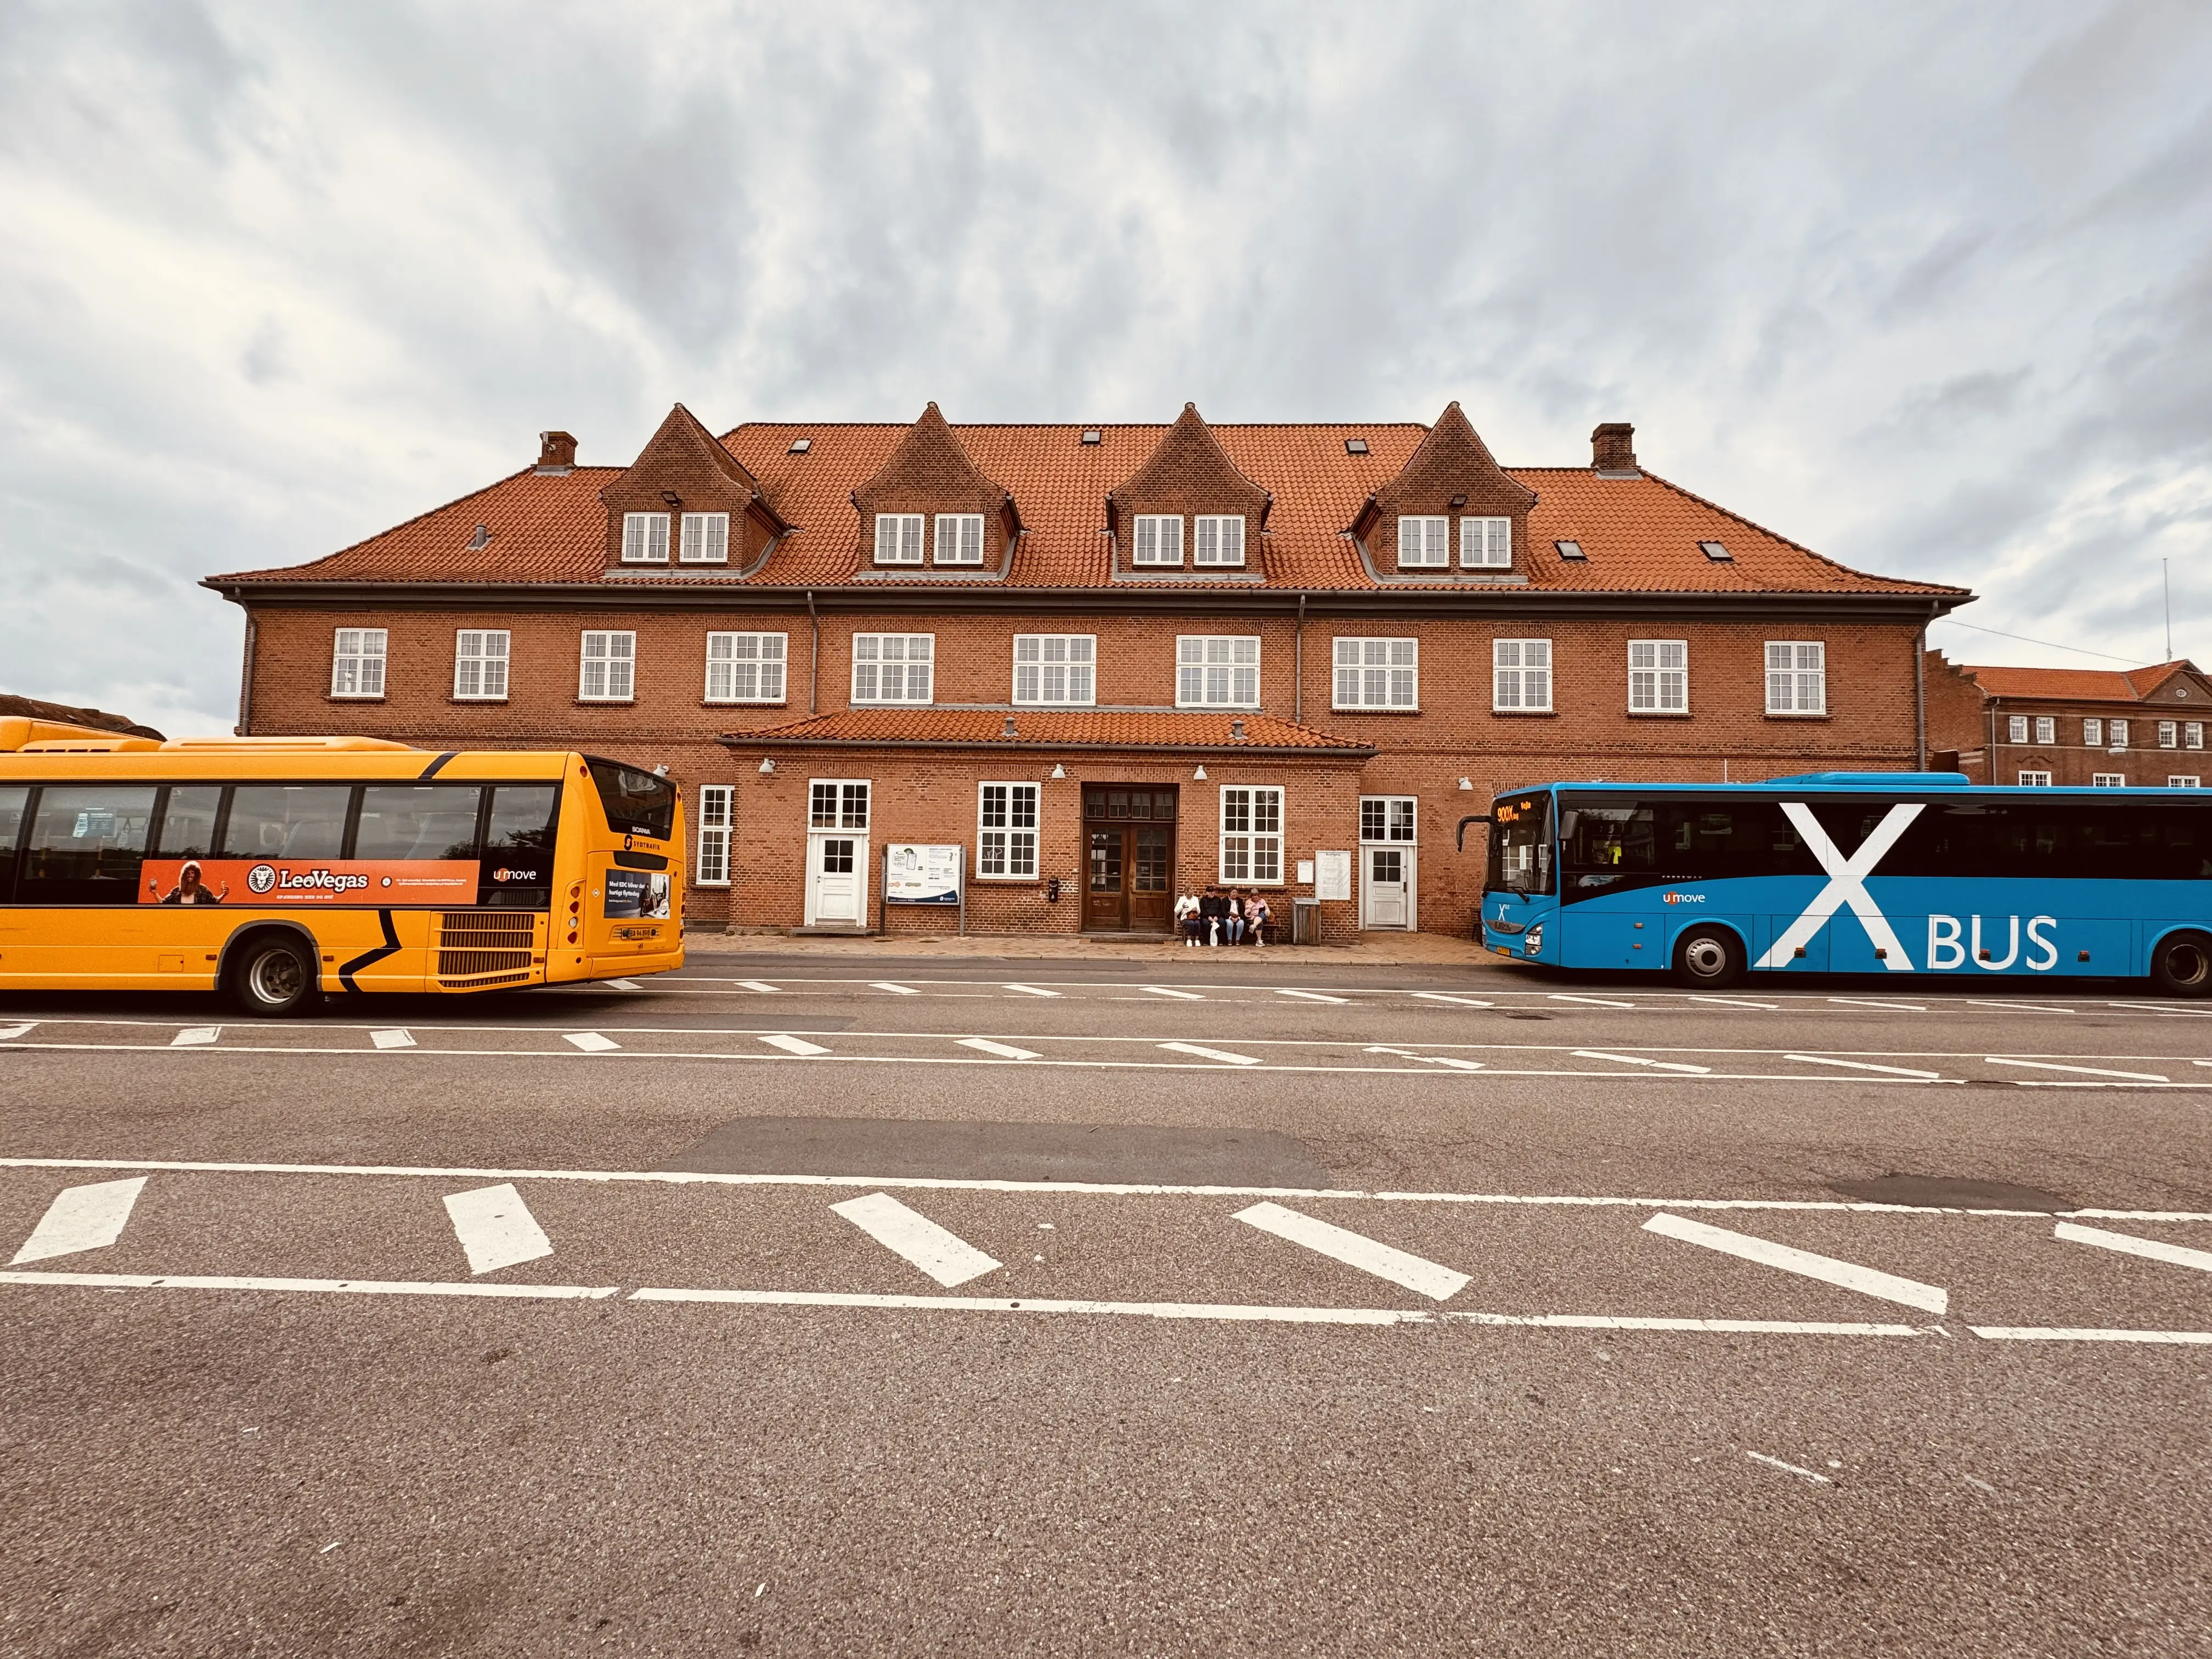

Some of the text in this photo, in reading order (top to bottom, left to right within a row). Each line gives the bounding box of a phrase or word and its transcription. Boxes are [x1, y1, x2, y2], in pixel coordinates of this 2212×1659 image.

[1497, 805, 1514, 822] 900X
[631, 826, 651, 834] SCANIA
[633, 840, 661, 850] SYDTRAFIK
[279, 870, 368, 892] LeoVegas
[1753, 803, 2058, 970] X BUS
